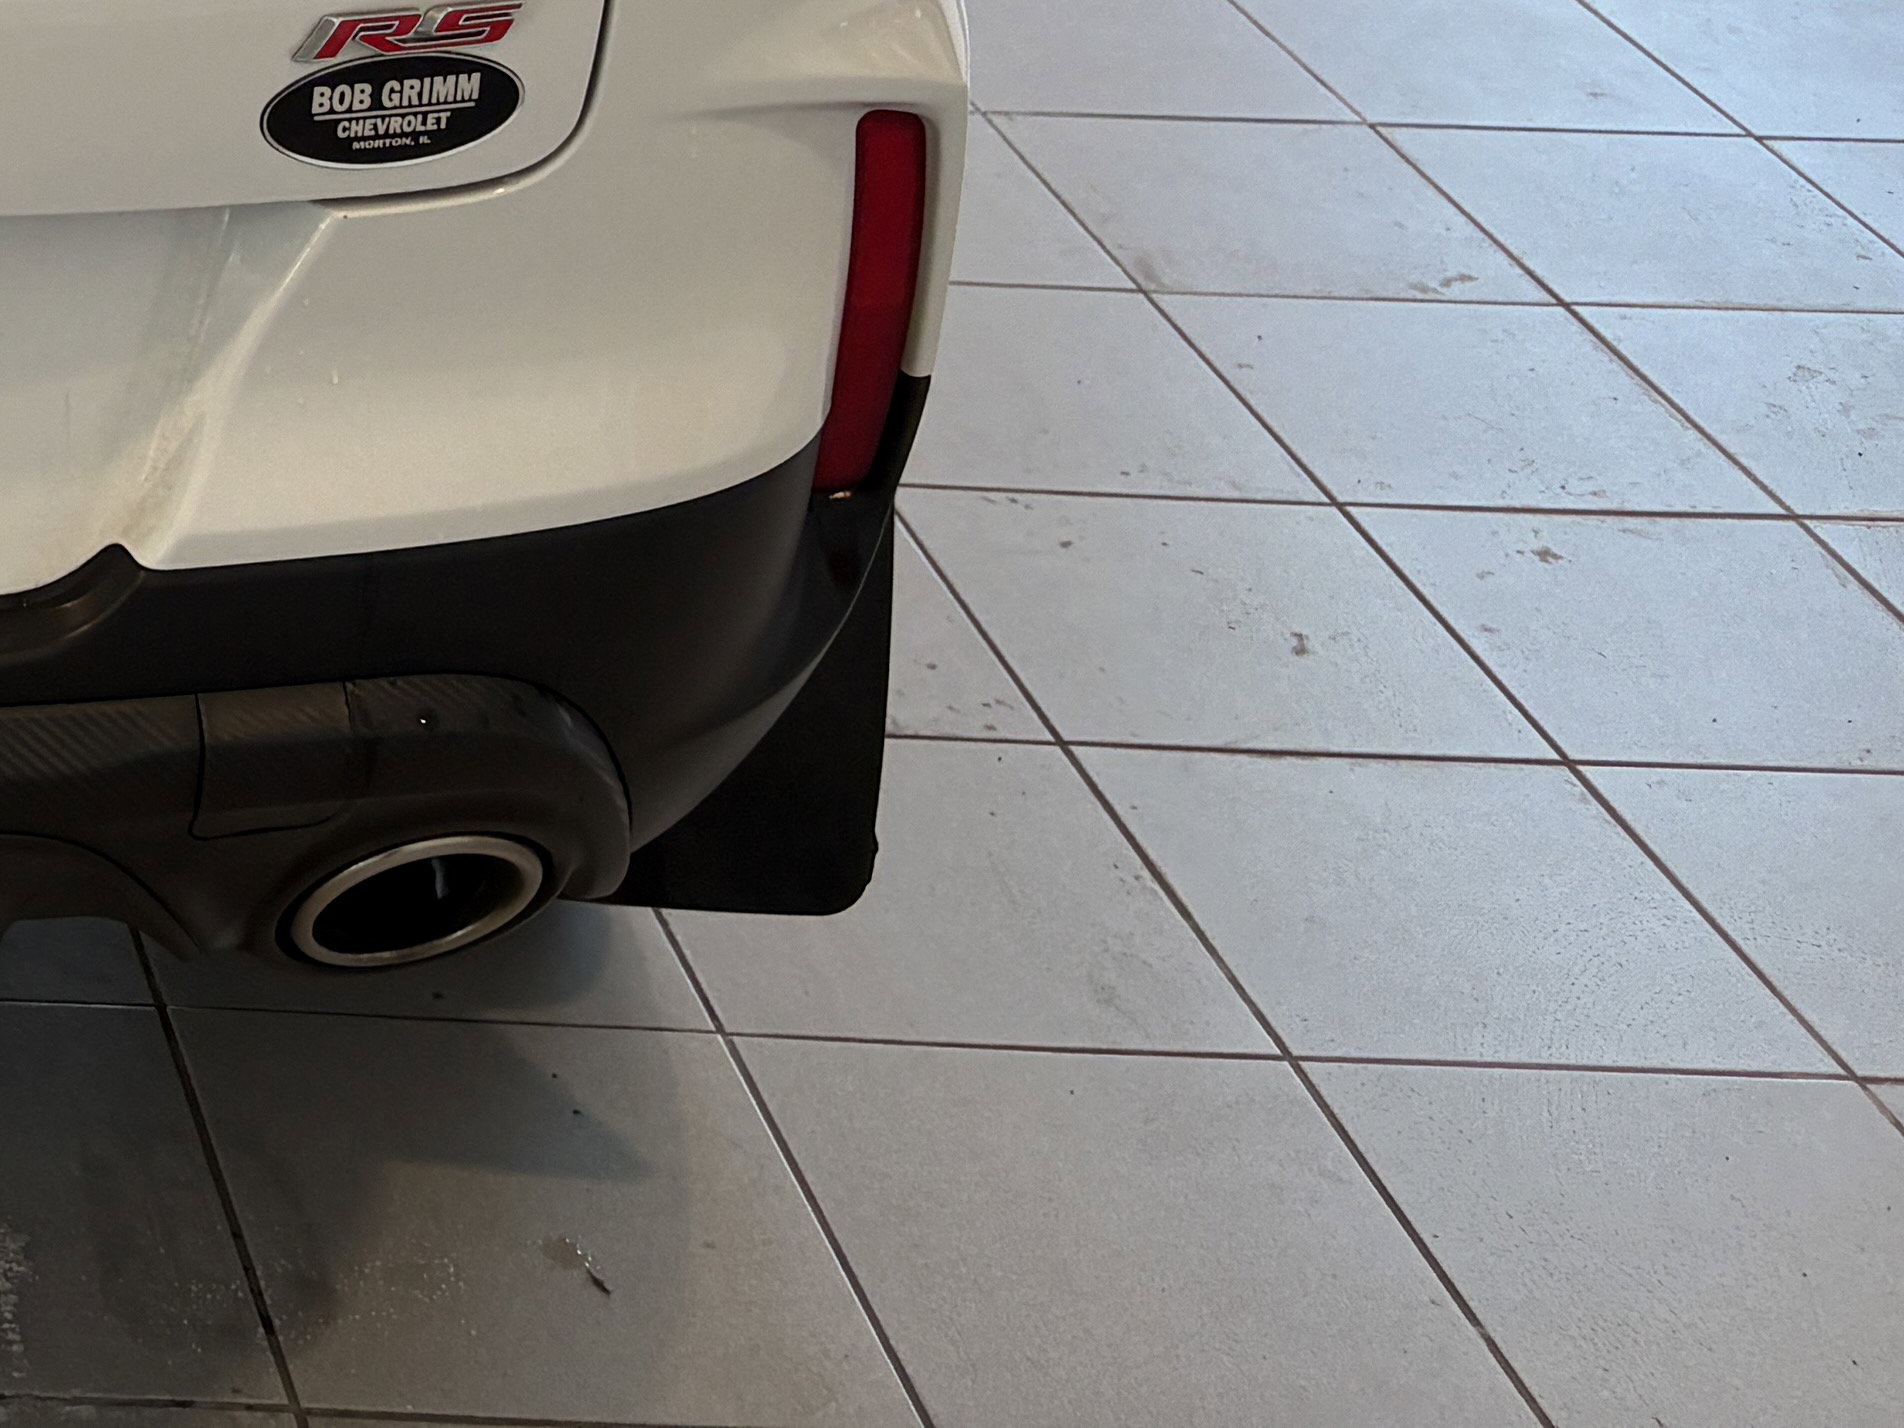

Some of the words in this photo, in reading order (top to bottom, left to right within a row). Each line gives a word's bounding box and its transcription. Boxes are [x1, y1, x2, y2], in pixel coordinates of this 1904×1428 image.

[311, 82, 373, 115] BOB
[381, 72, 482, 109] GRIMM
[336, 111, 452, 139] CHEVROLET
[351, 135, 415, 151] MORTON,
[419, 135, 432, 145] IL
